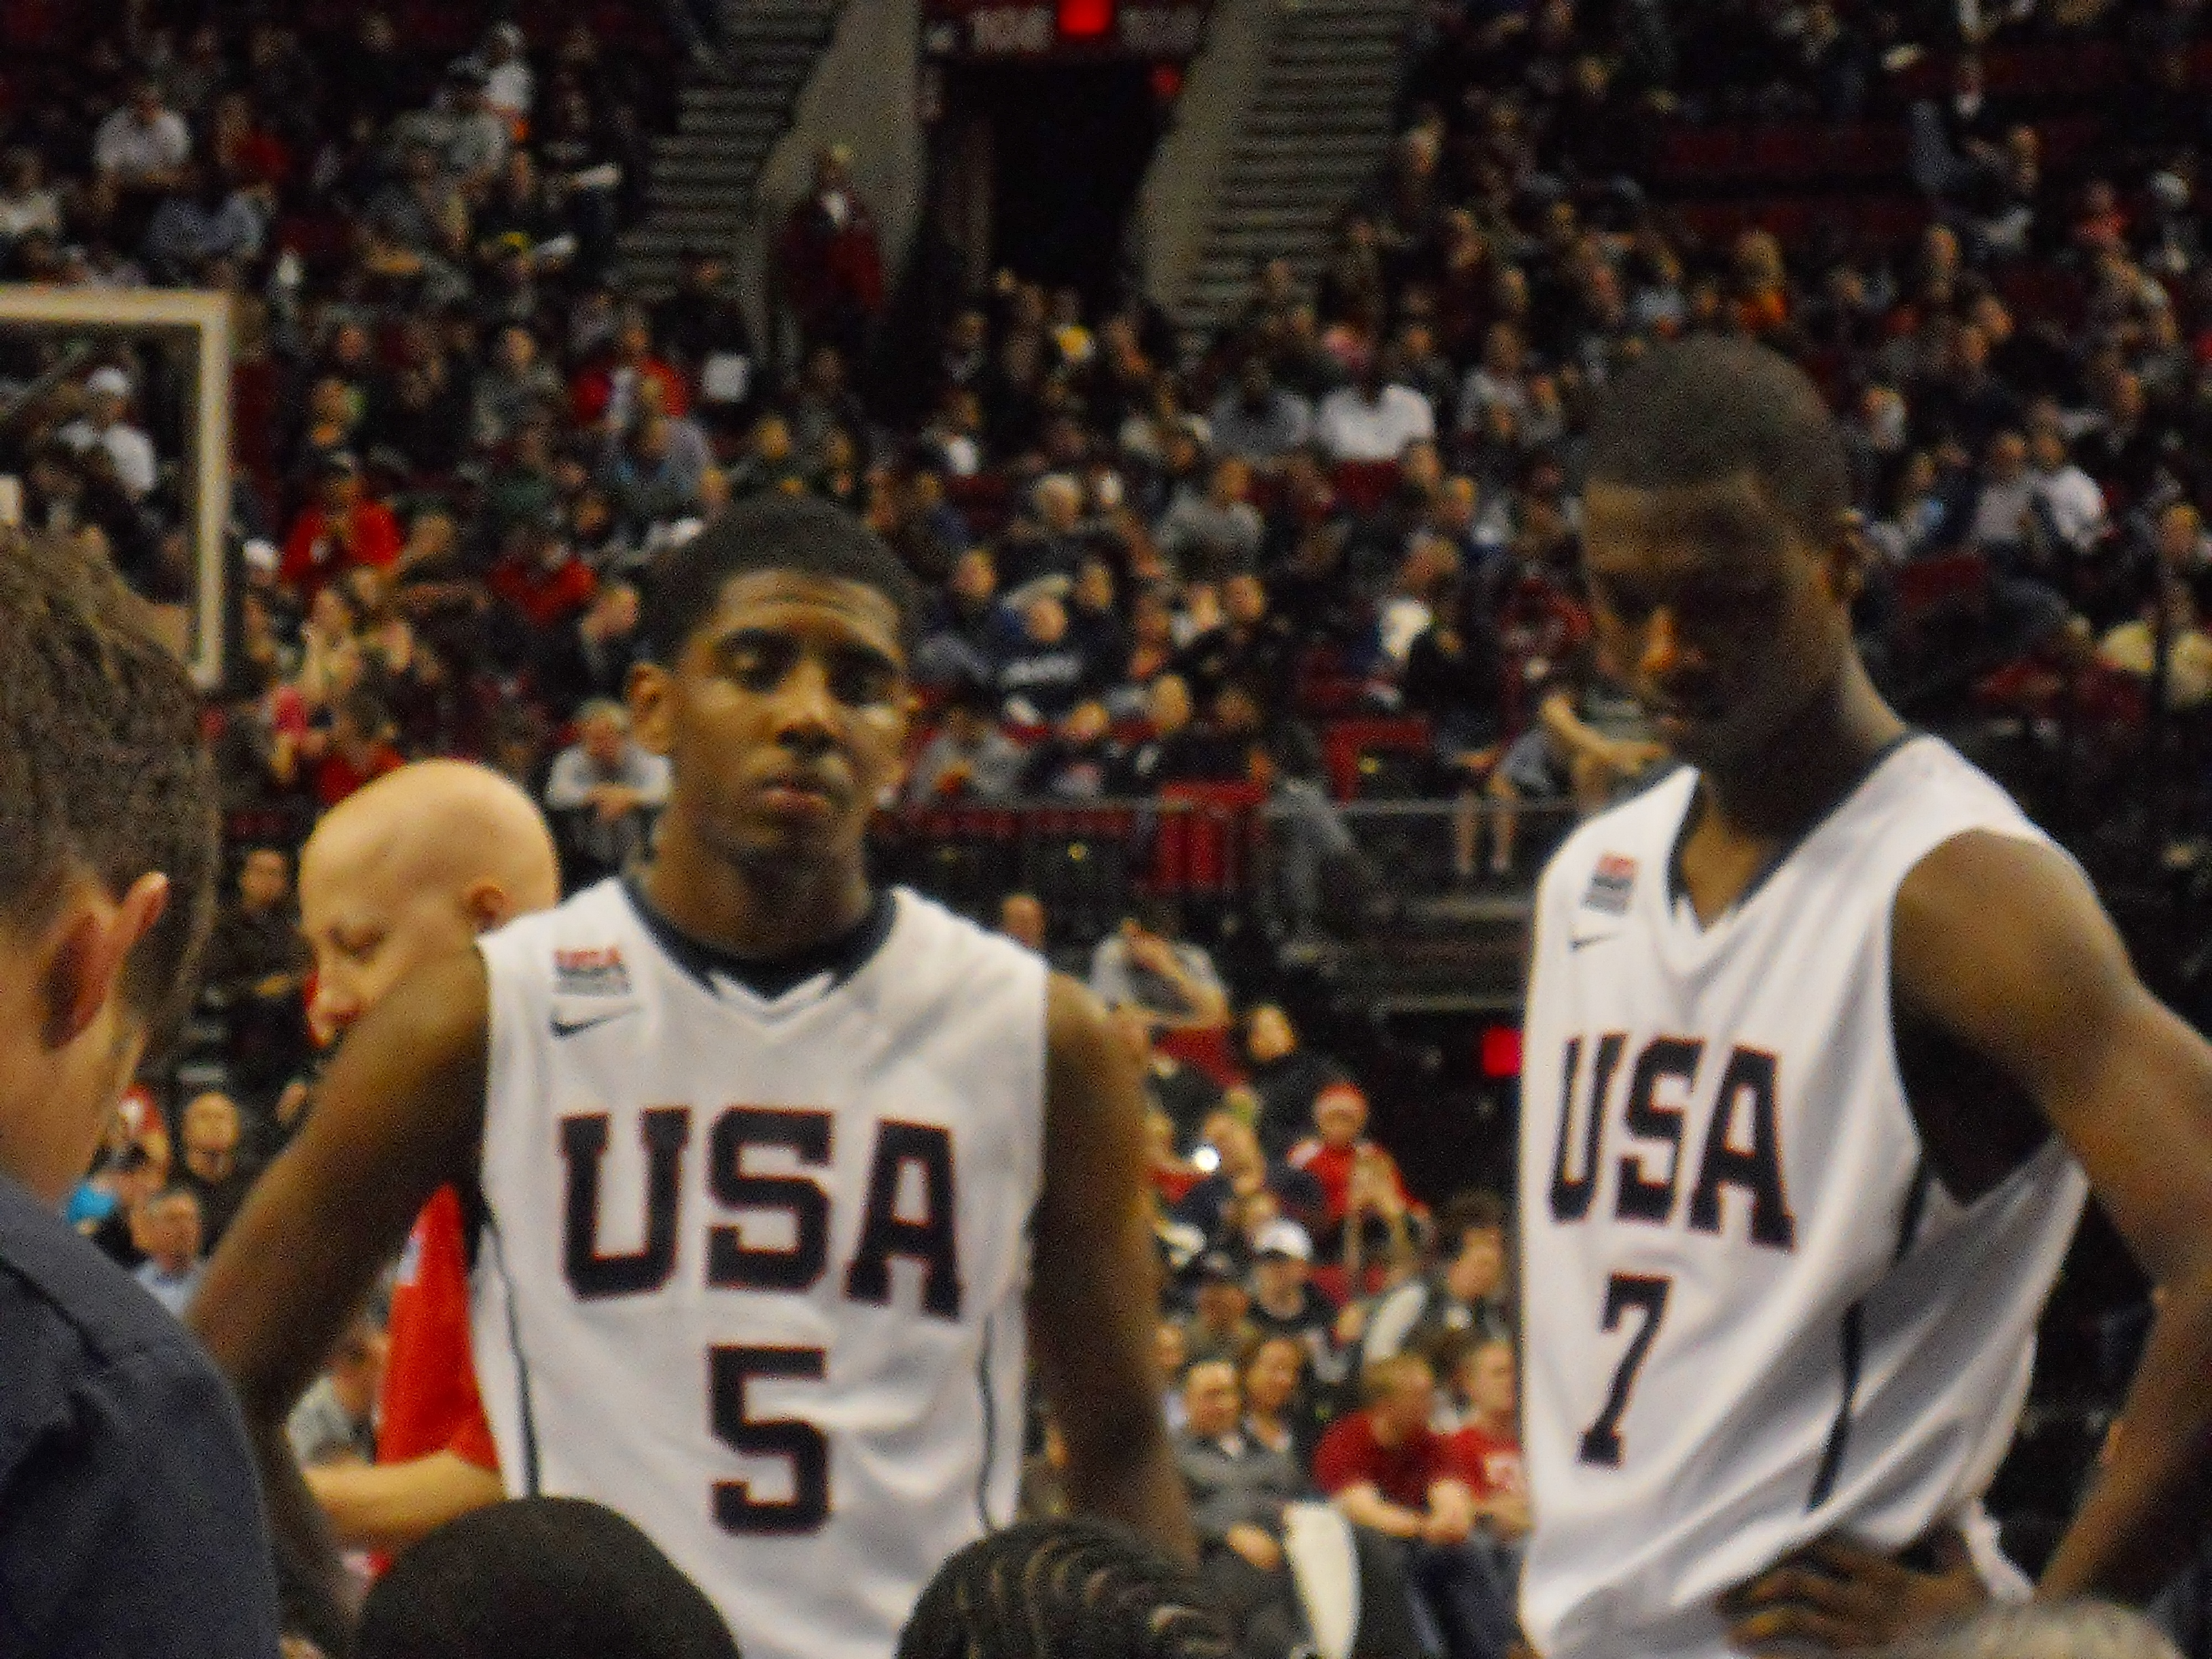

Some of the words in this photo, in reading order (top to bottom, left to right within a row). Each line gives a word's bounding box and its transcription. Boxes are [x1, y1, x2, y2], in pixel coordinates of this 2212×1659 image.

[560, 1105, 960, 1318] USA
[1550, 1032, 1796, 1250] USA
[708, 1344, 832, 1535] 5
[1579, 1272, 1671, 1468] 7
